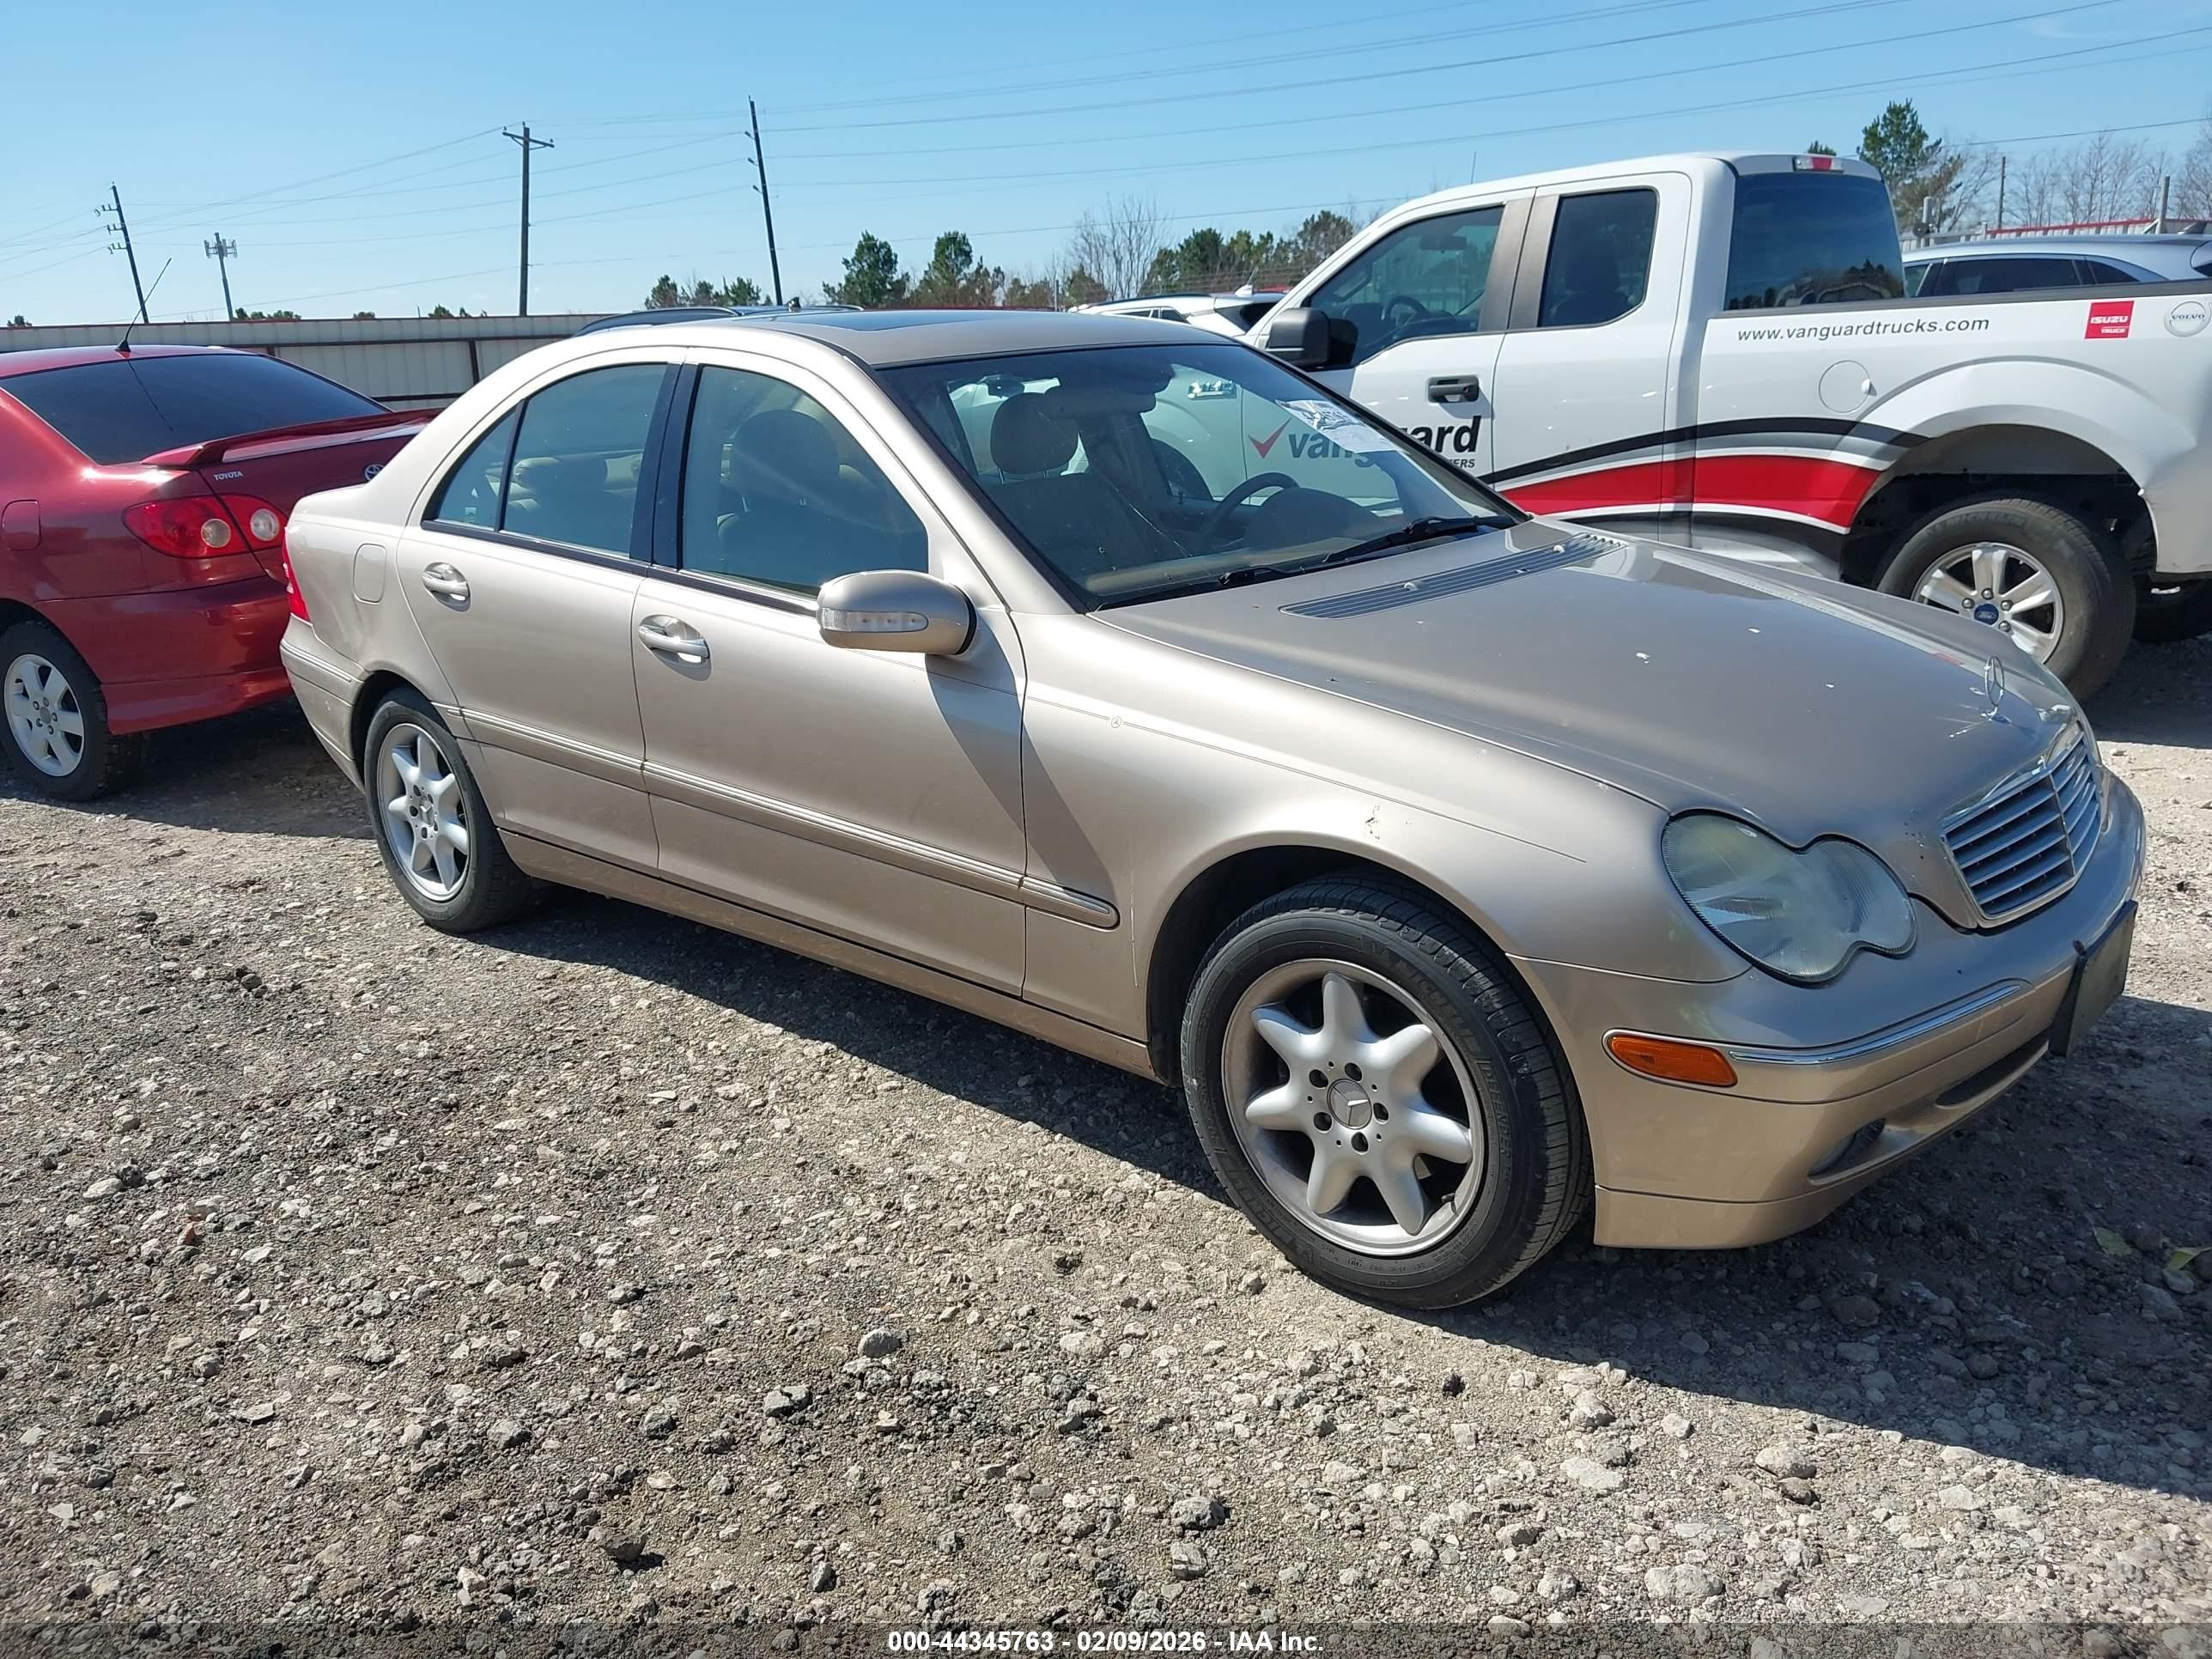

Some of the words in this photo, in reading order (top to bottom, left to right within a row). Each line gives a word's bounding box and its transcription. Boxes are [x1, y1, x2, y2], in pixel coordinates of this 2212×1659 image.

[2090, 315, 2129, 325] ISUZU
[1737, 319, 1990, 342] www.vanguardtrucks.com
[213, 471, 245, 481] TOYOTA
